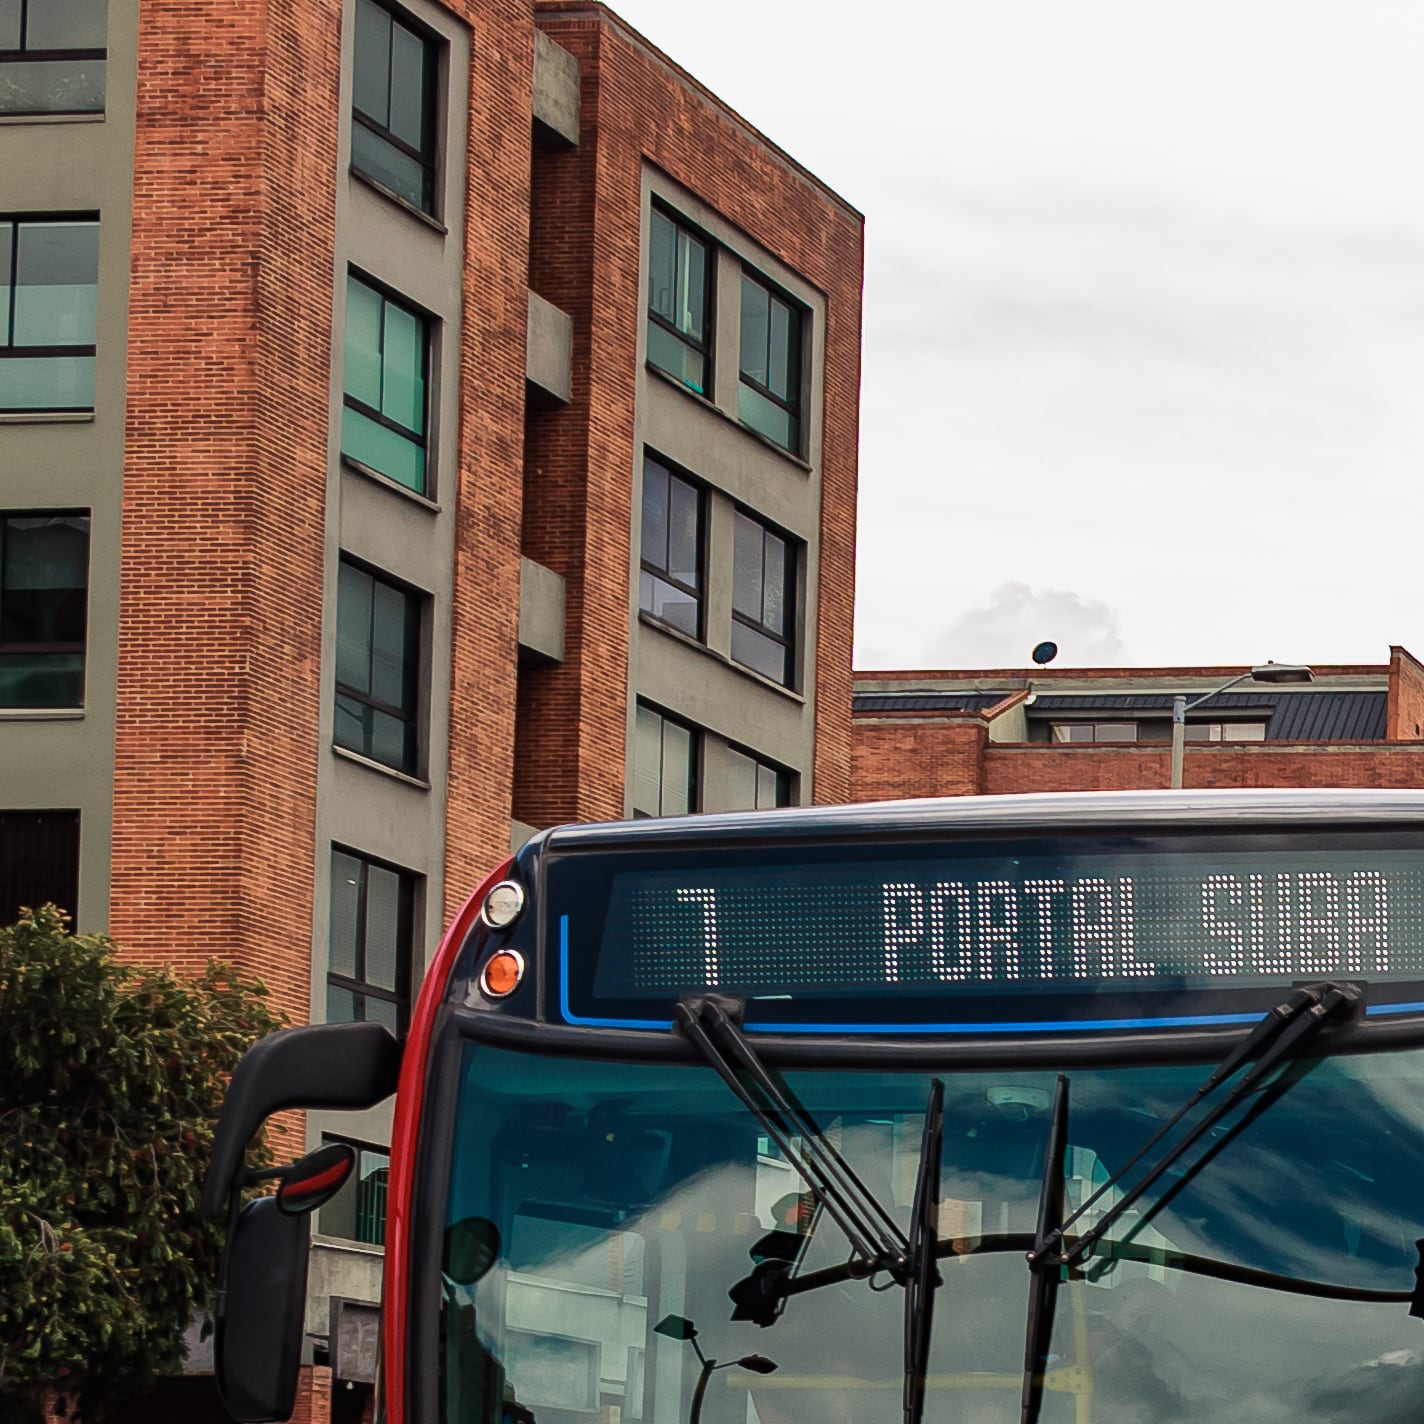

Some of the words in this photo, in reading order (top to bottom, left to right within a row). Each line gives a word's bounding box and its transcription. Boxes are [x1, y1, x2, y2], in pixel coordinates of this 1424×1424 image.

[676, 888, 718, 985] 7
[882, 877, 1156, 983] PORTAL
[1201, 871, 1389, 975] SUBA
